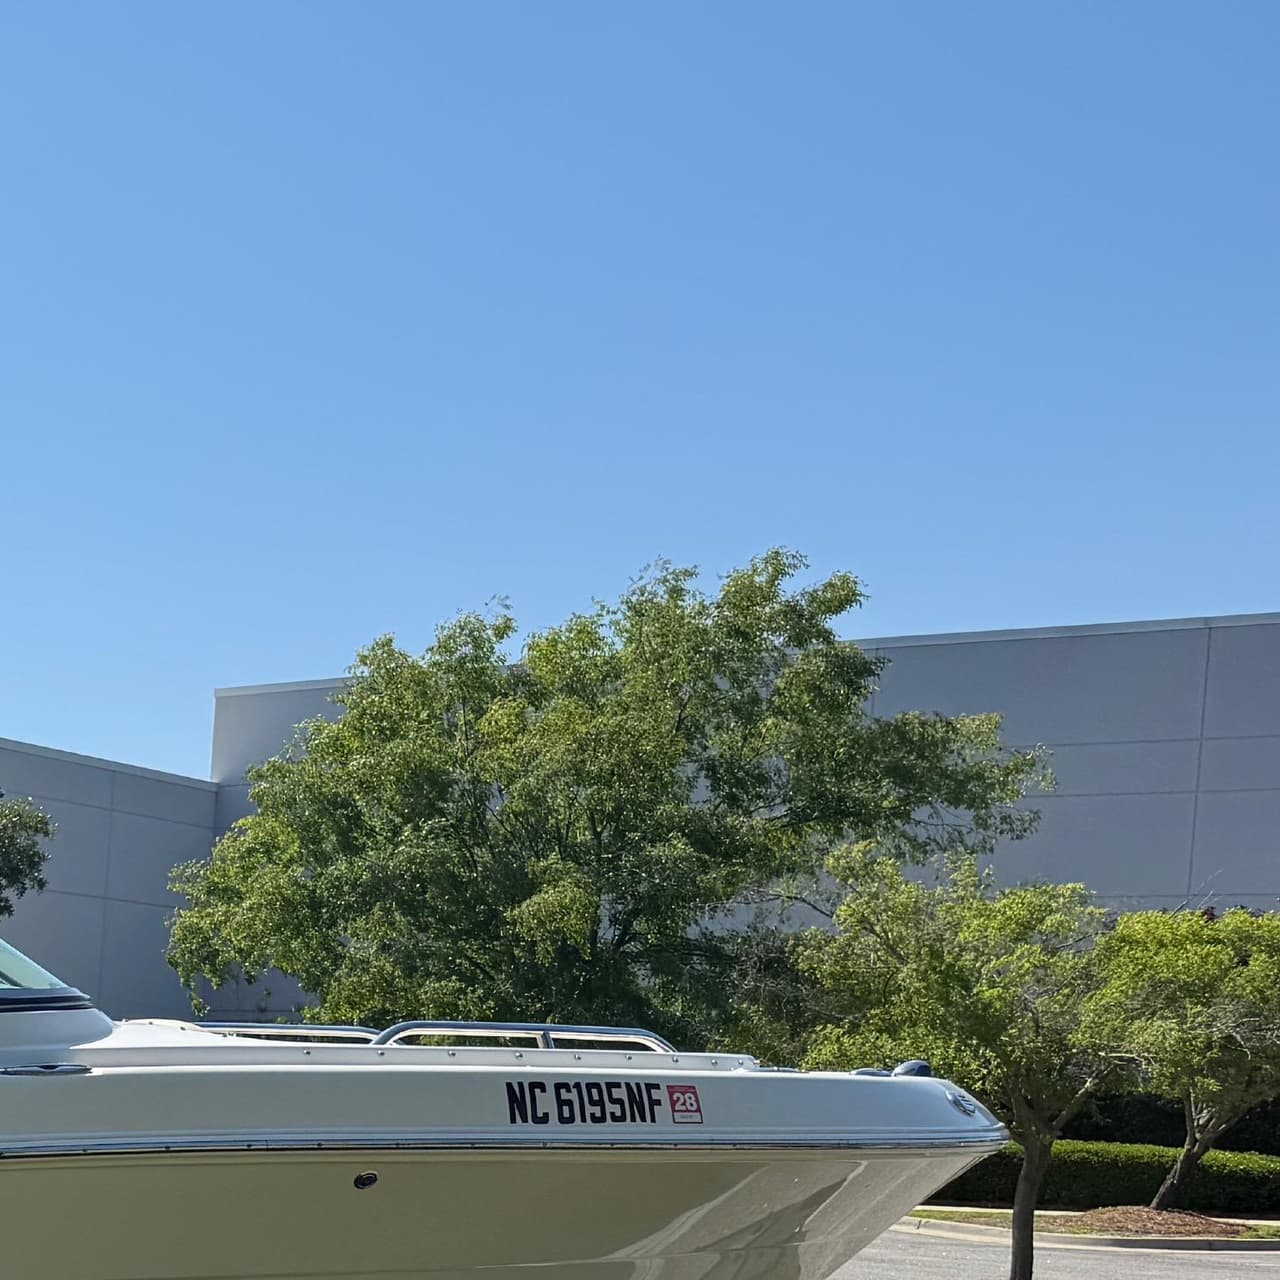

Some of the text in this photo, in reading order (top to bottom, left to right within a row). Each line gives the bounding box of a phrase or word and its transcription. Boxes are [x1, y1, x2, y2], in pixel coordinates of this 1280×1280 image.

[506, 1081, 662, 1124] NC 6195NF
[673, 1092, 697, 1111] 28
